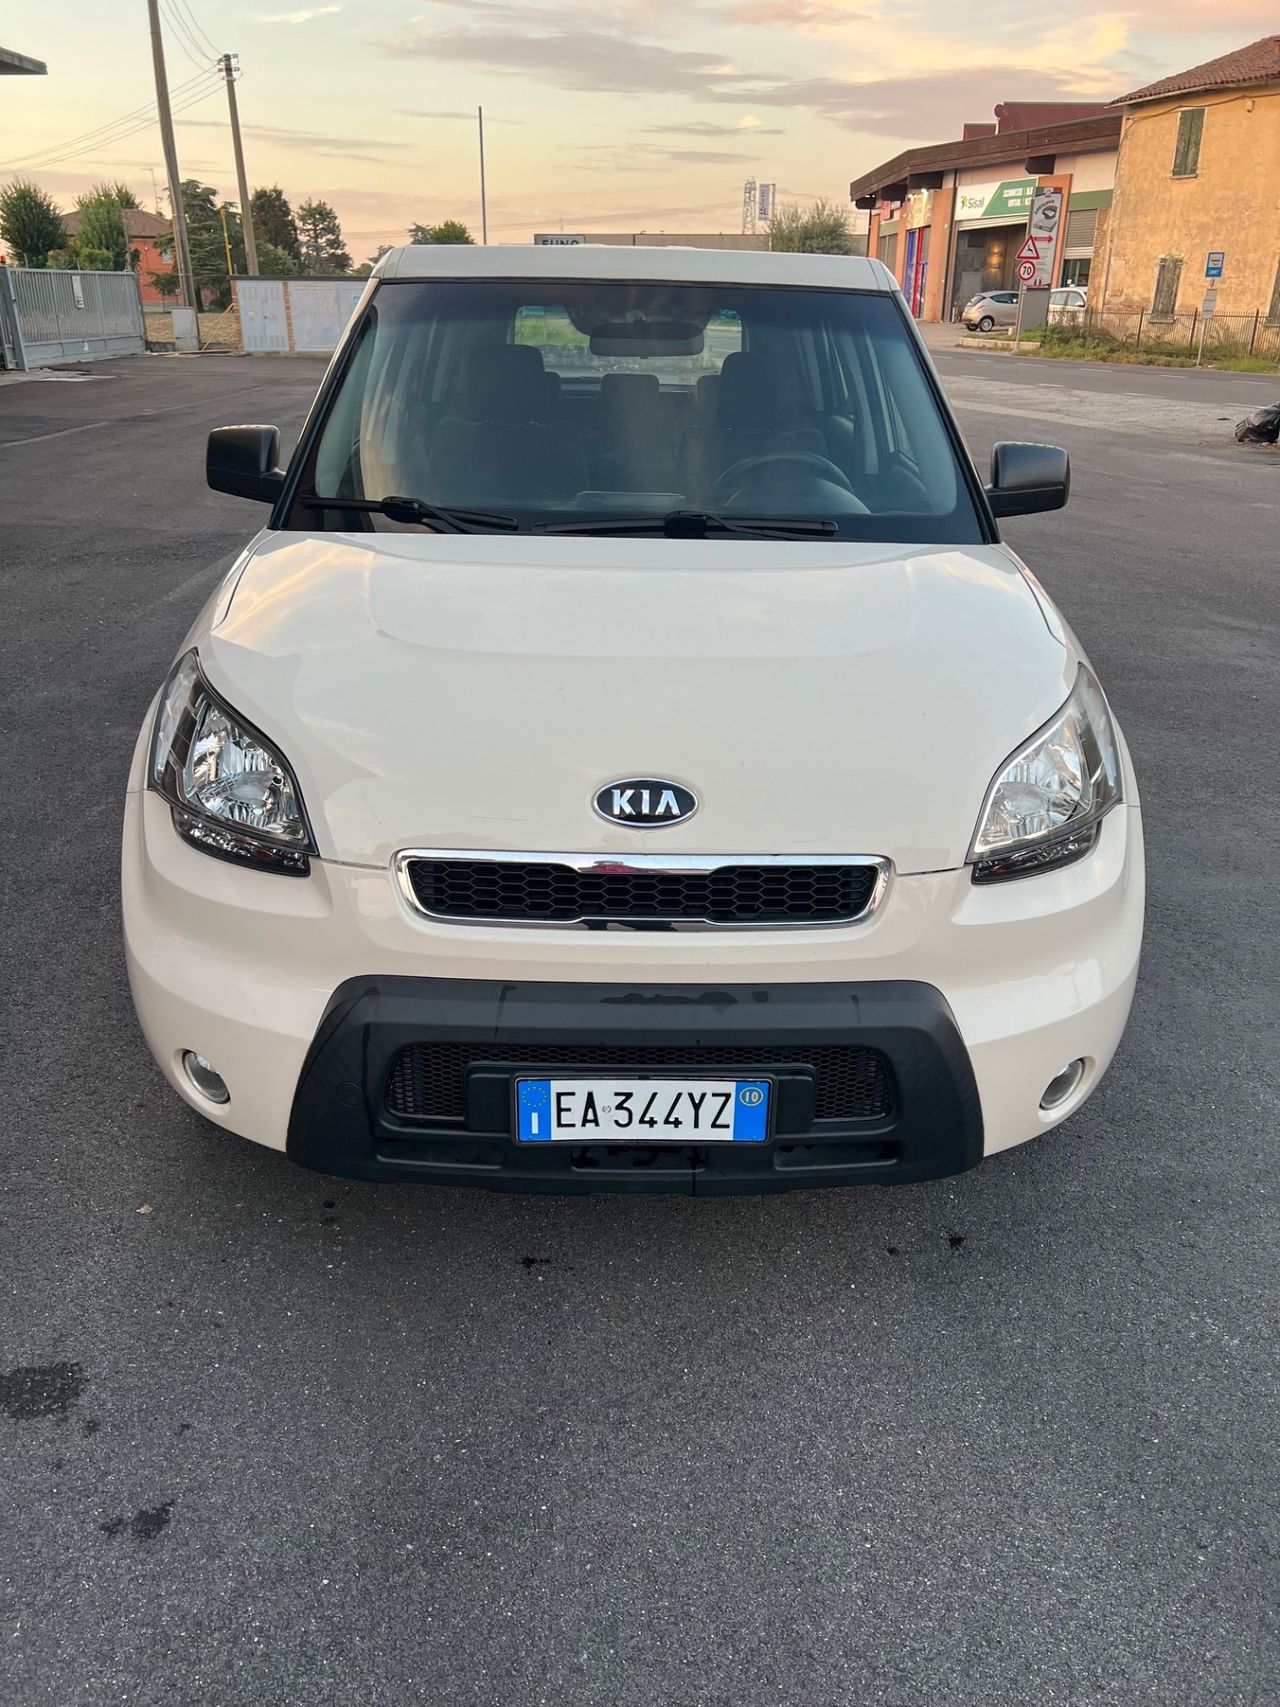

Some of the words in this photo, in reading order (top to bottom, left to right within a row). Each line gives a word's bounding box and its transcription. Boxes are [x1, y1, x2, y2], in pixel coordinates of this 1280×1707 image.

[968, 196, 984, 208] Sisal
[1022, 265, 1031, 275] 70
[611, 789, 681, 816] KIA
